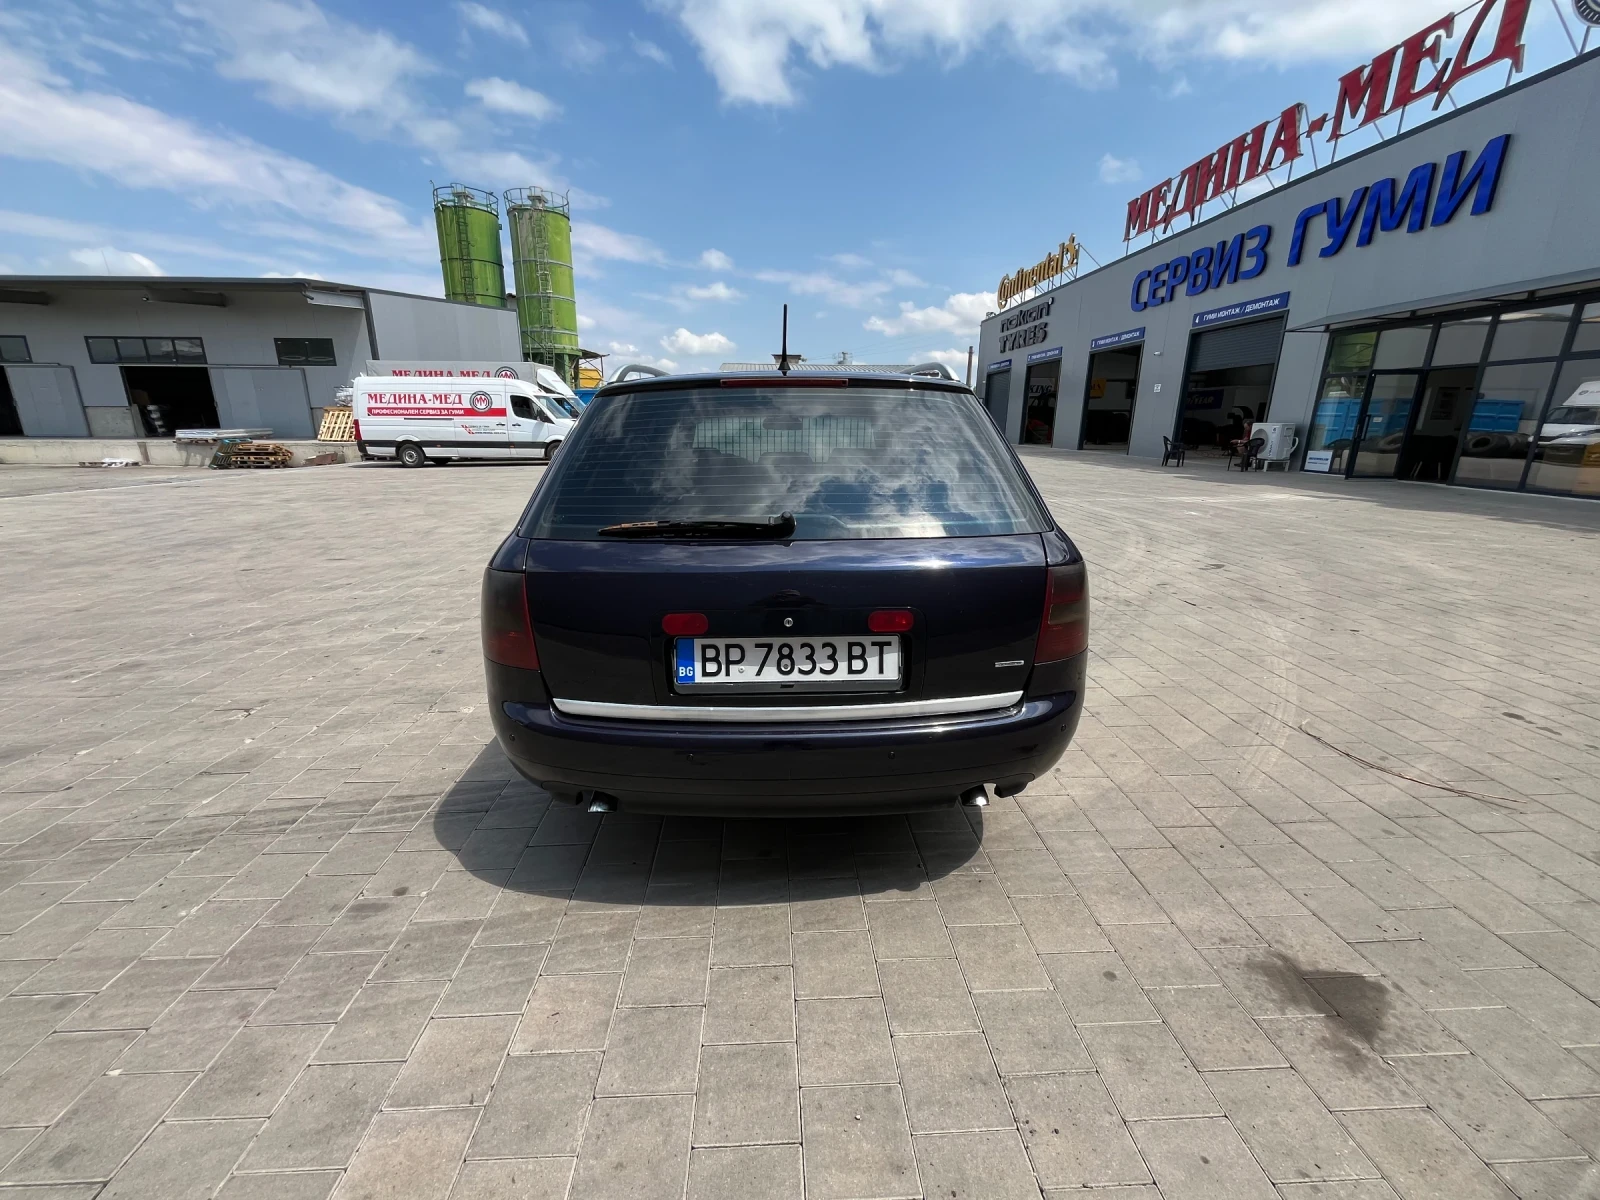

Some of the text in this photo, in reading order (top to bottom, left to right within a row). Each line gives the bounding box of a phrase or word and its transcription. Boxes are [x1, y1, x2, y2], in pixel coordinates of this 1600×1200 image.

[1123, 0, 1531, 241] МЕДИНА-МЕД
[1131, 133, 1511, 312] СЕРВИЗ ГУМИ
[997, 242, 1066, 309] Continental
[999, 322, 1048, 353] TYRES
[368, 393, 464, 406] МЕДИНА-МЕД
[679, 666, 694, 677] BG
[701, 640, 893, 677] BP 7833 BT
